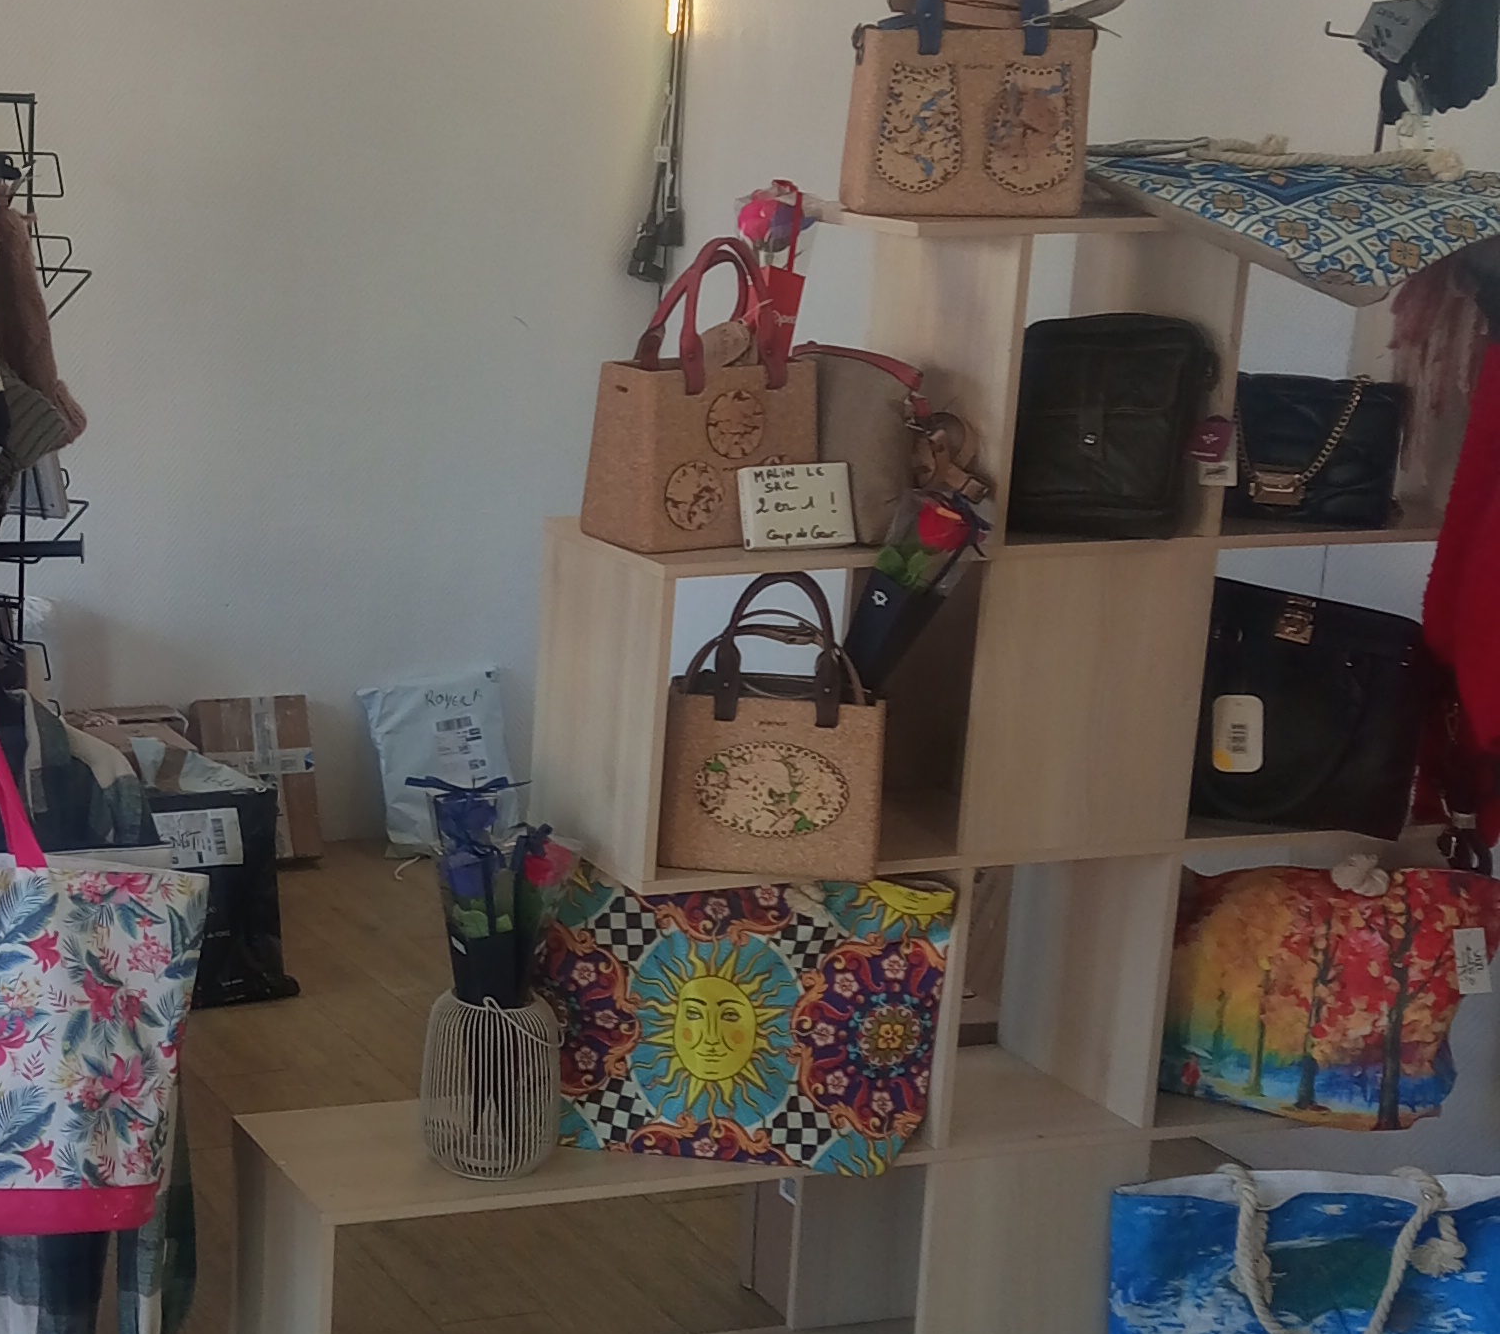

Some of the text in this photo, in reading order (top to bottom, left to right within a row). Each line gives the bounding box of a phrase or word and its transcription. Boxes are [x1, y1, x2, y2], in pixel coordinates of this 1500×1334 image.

[806, 467, 825, 477] LE
[764, 481, 799, 493] SAC
[756, 497, 769, 514] 2
[800, 496, 815, 509] 1
